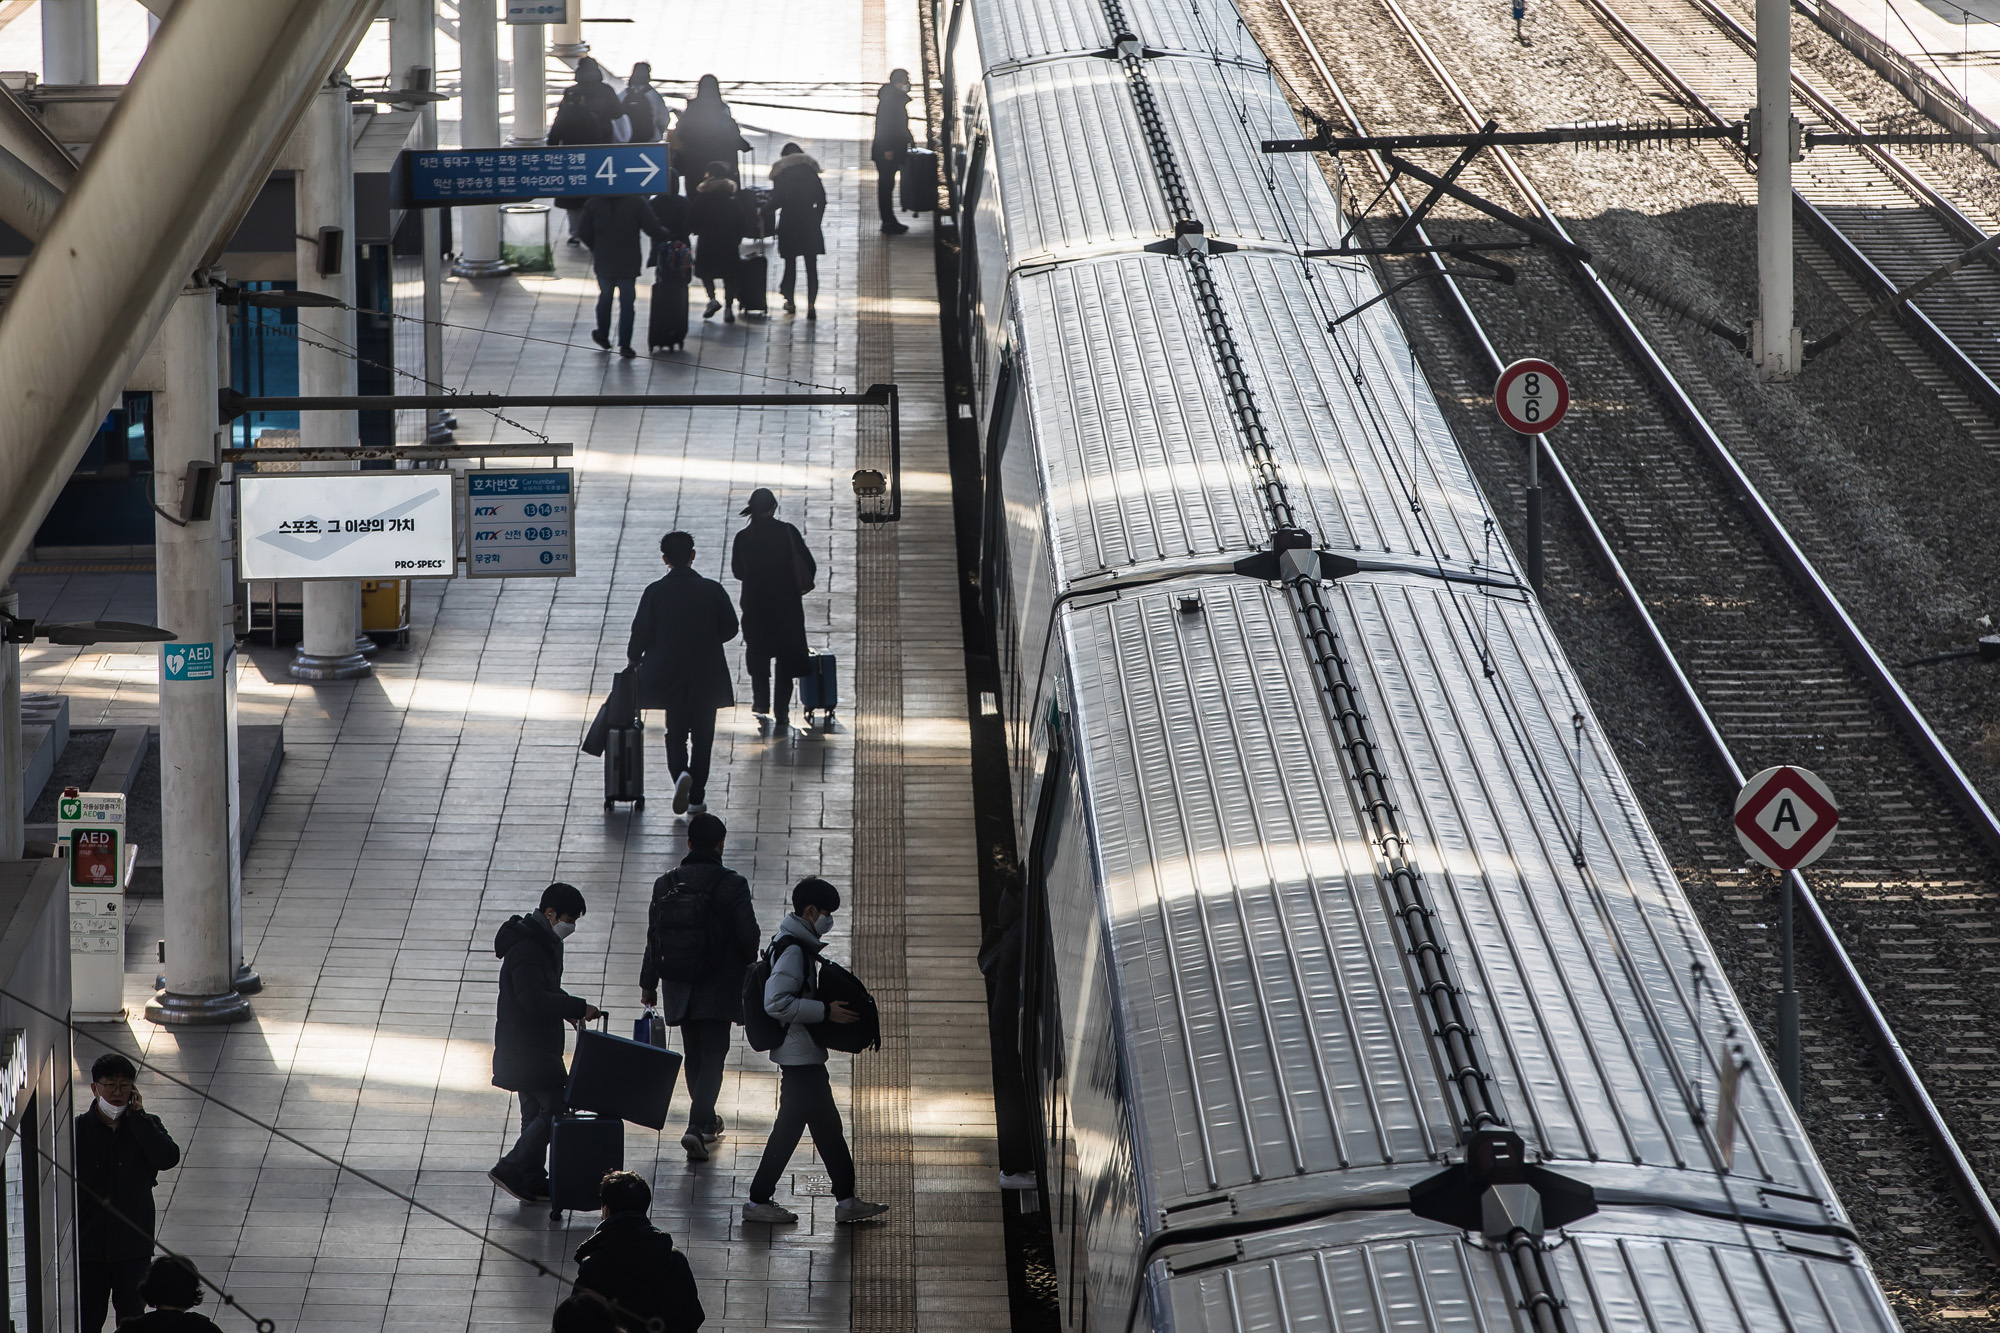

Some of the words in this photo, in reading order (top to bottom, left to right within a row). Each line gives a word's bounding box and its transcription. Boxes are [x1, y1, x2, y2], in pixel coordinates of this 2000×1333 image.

[475, 156, 494, 167] 부산
[594, 156, 618, 186] 4
[1525, 373, 1540, 396] 8
[1525, 399, 1540, 422] 6
[473, 479, 519, 491] 호차번호
[474, 505, 504, 516] KTX
[525, 505, 536, 516] 13
[540, 504, 551, 515] 14
[279, 521, 322, 534] 스포츠,
[328, 520, 340, 532] 그
[345, 519, 384, 532] 이상의
[388, 518, 415, 531] 가치
[475, 530, 504, 540] KTX
[505, 530, 521, 540] 산천
[526, 529, 537, 539] 12
[540, 528, 552, 539] 13
[475, 554, 500, 564] 무궁화
[188, 647, 211, 660] AED
[1772, 798, 1801, 832] A
[80, 832, 109, 844] AED
